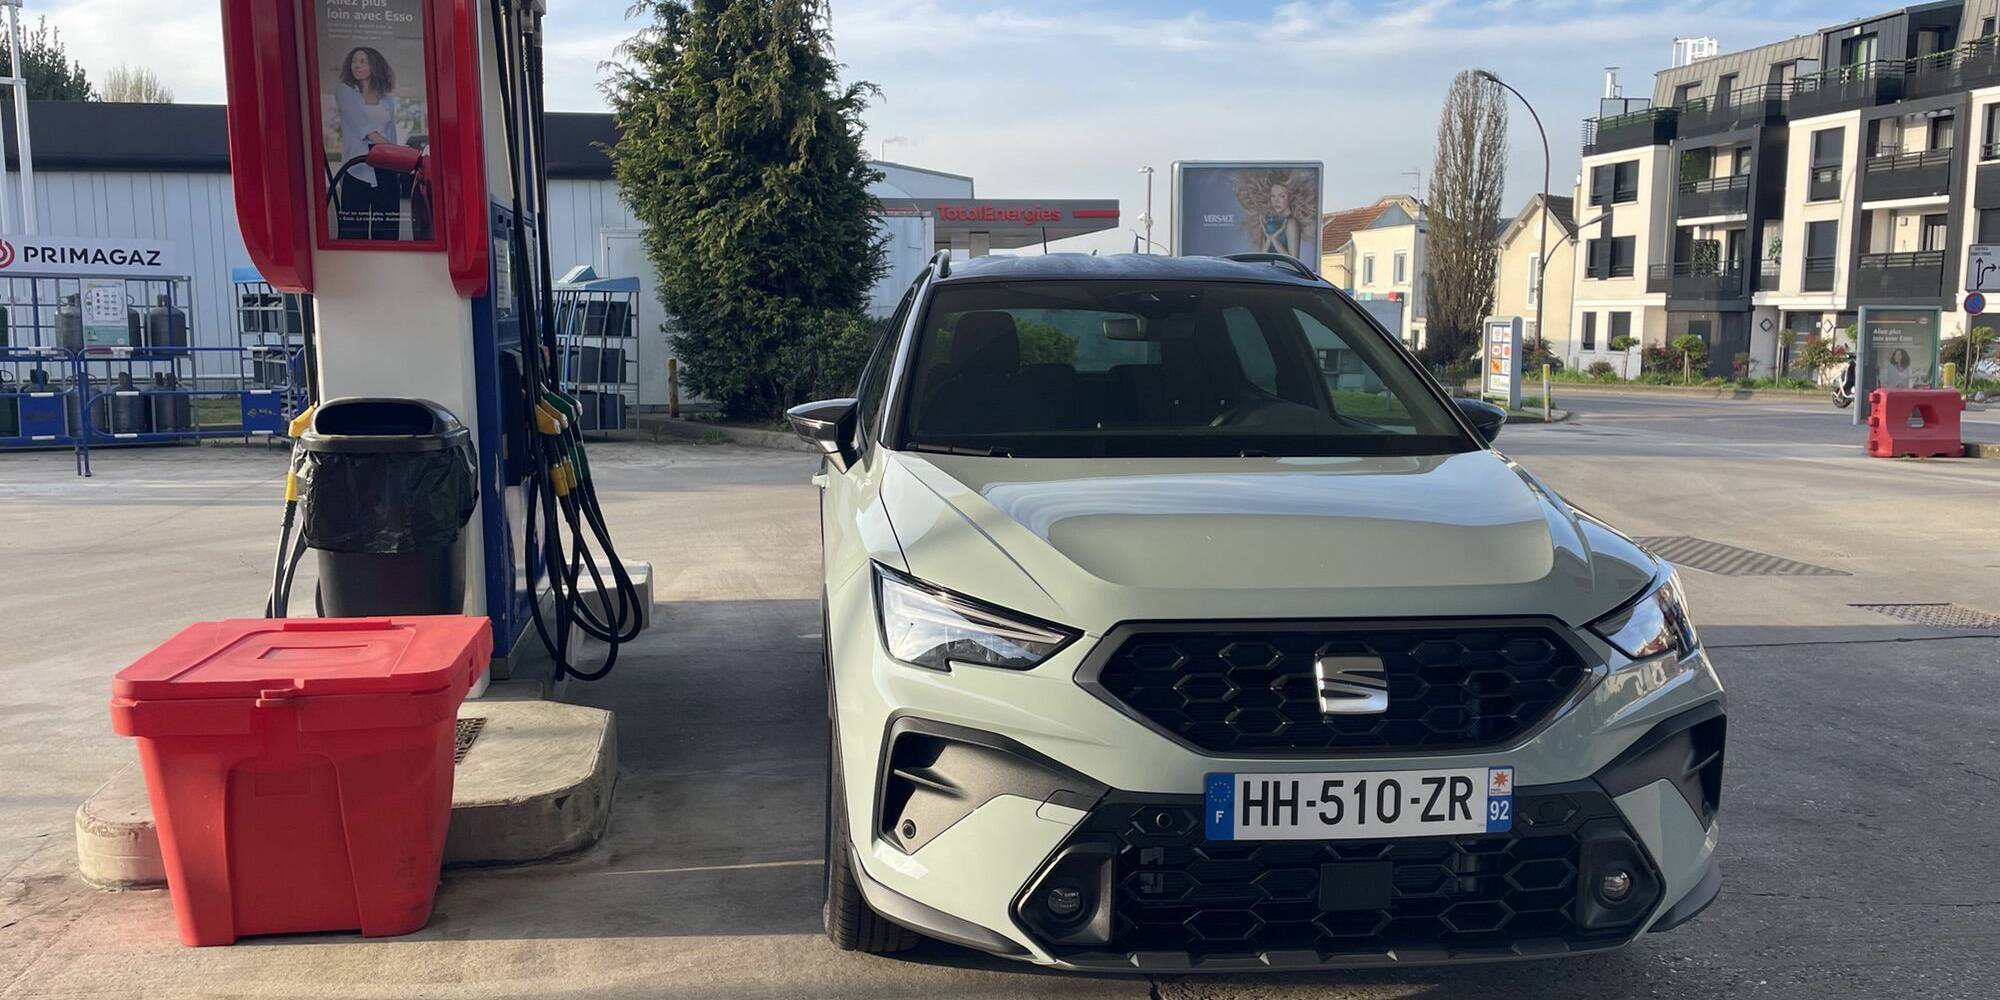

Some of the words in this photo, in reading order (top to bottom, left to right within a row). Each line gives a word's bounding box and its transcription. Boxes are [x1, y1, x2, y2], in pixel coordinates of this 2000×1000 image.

[327, 8, 350, 20] loin
[353, 11, 383, 21] avec
[385, 11, 414, 22] Esso
[937, 204, 1062, 225] TotalEnergies
[1203, 214, 1233, 223] VERSACE
[23, 246, 161, 266] PRIMAGAZ
[1215, 810, 1225, 823] F
[1241, 775, 1473, 828] HH-510-ZR
[1490, 800, 1509, 821] 92
